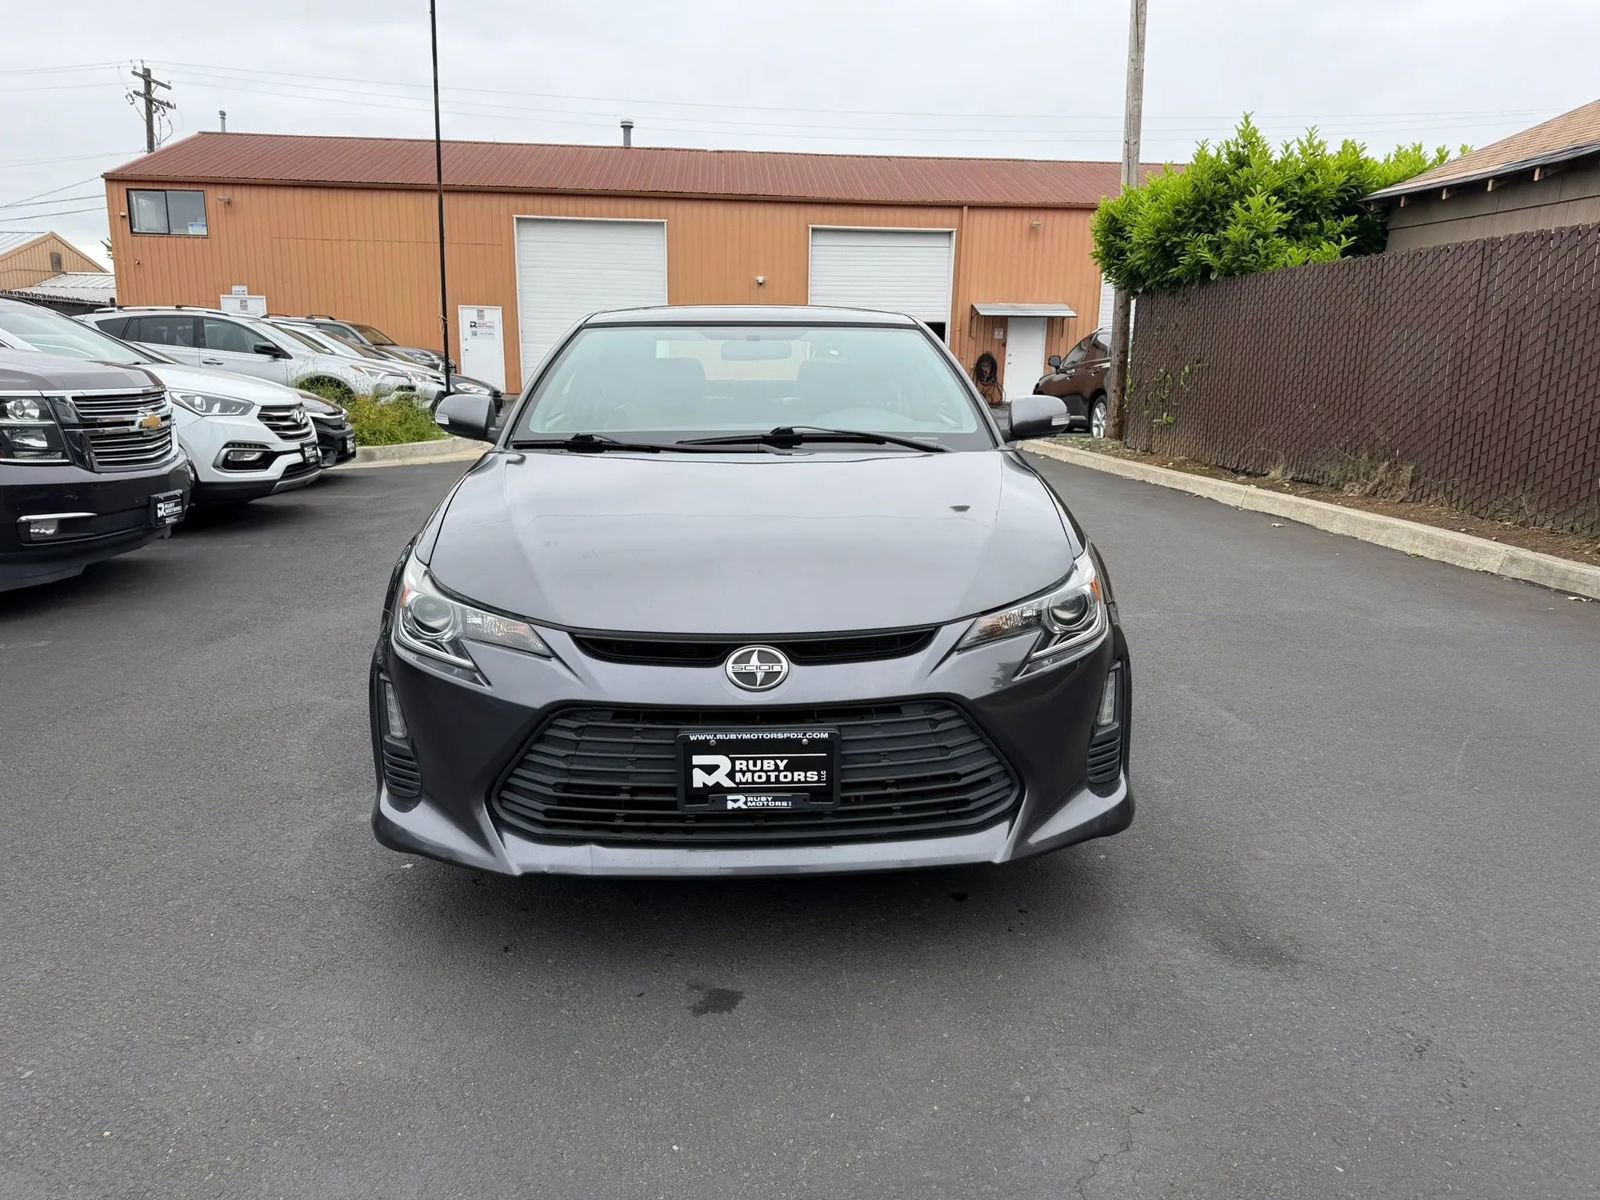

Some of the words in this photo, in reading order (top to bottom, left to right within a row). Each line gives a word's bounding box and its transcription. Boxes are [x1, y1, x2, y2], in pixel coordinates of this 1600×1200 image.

[731, 664, 783, 672] SCION
[689, 732, 829, 741] WWW.RUBYMOTORSPDX.COM
[735, 759, 789, 771] RUBY
[735, 770, 819, 783] MOTORS
